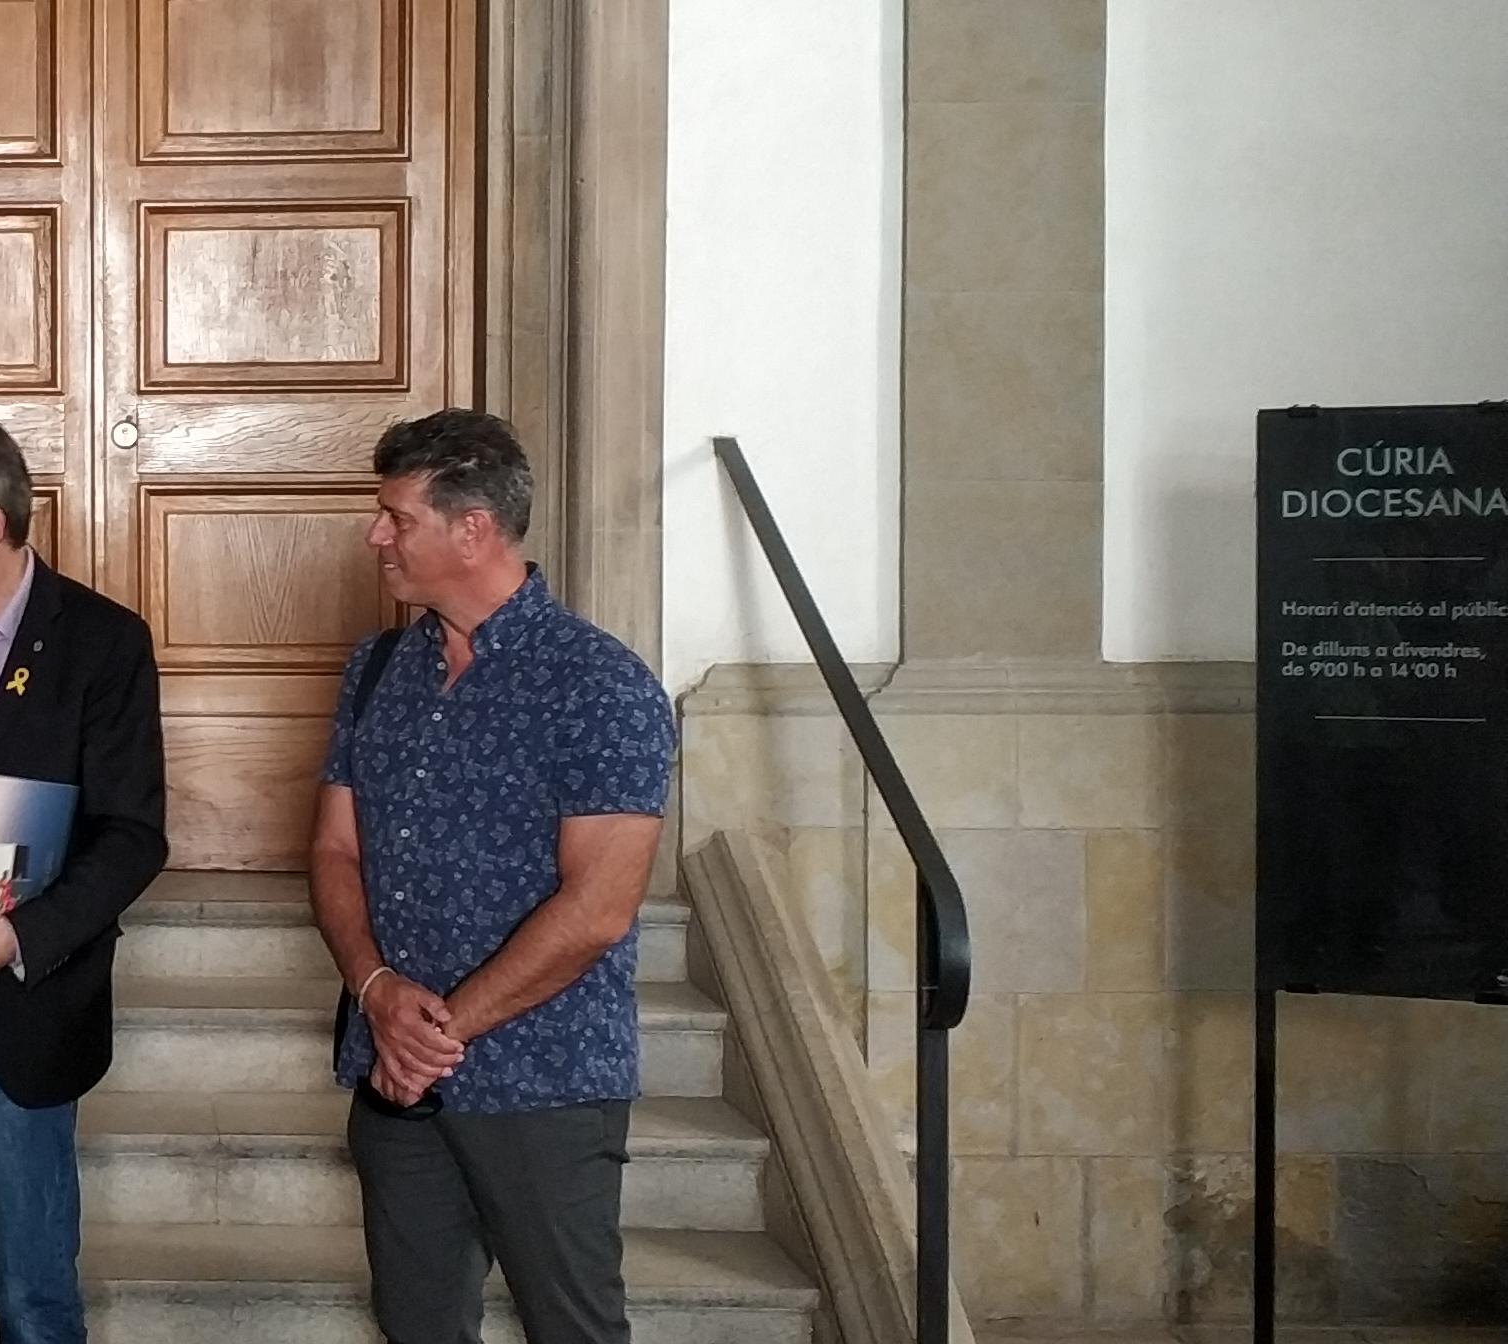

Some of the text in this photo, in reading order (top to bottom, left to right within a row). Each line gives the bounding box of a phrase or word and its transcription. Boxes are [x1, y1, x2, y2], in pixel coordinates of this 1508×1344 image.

[1336, 439, 1455, 476] CÚRIA
[1281, 487, 1508, 519] DIOCESANA
[1281, 600, 1339, 617] Horari
[1428, 600, 1447, 617] al
[1451, 600, 1508, 622] públic
[1281, 640, 1487, 661] De dilluns a divendres,
[1281, 660, 1305, 677] de
[1353, 661, 1366, 677] h
[1370, 666, 1384, 678] a
[1444, 662, 1458, 678] h
